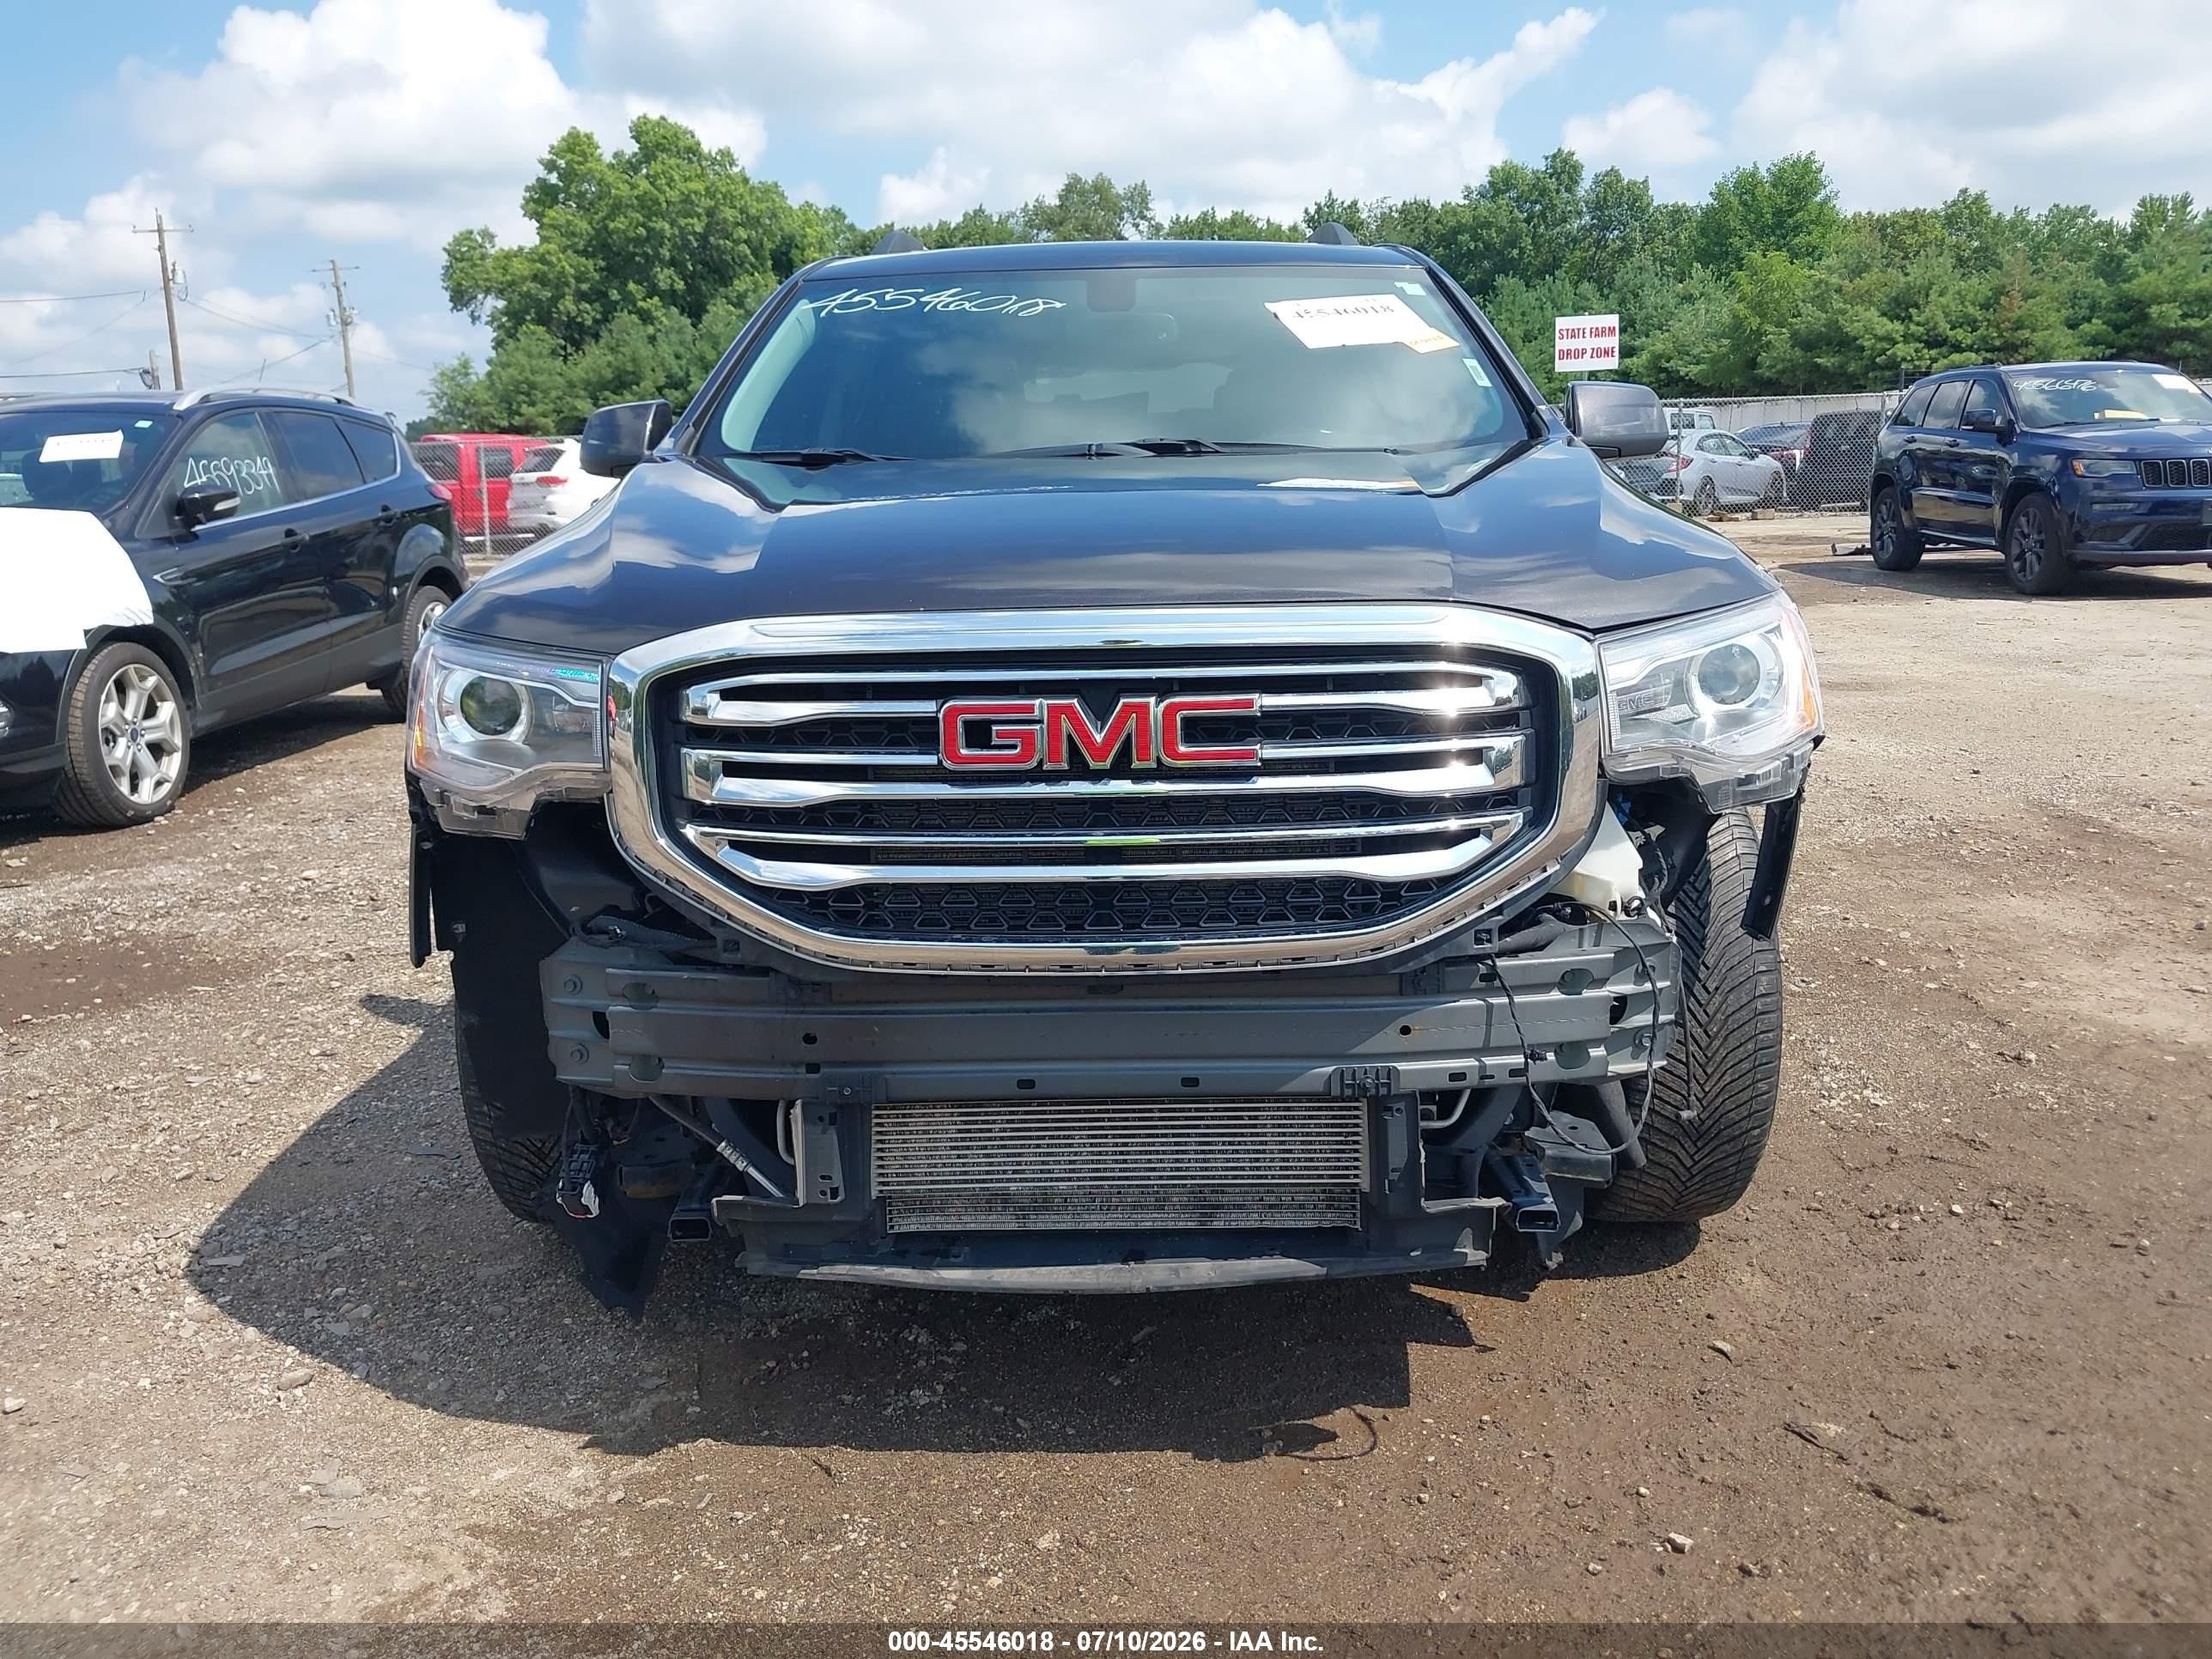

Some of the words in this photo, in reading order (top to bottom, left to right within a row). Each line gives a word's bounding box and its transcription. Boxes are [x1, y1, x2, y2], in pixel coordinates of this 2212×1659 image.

[1558, 327, 1587, 341] STATE
[1589, 325, 1616, 338] FARM
[1558, 348, 1587, 361] DROP
[1589, 346, 1616, 359] ZONE
[939, 691, 1261, 770] GMC
